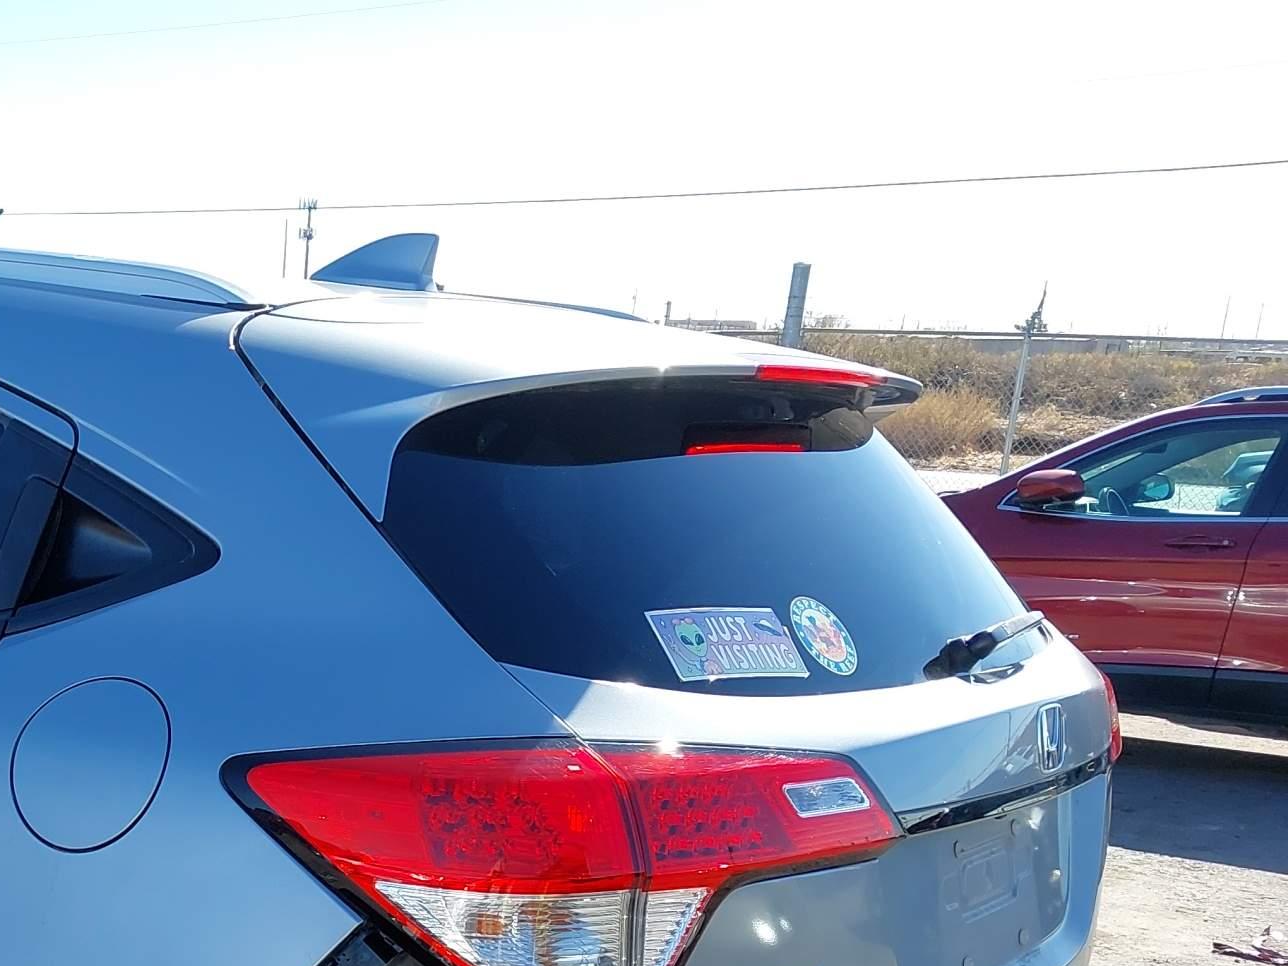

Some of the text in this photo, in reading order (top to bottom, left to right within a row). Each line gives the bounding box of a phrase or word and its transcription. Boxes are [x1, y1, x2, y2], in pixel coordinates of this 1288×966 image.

[792, 599, 839, 625] RESPECT
[704, 616, 753, 643] JUST
[710, 643, 797, 670] VISITING
